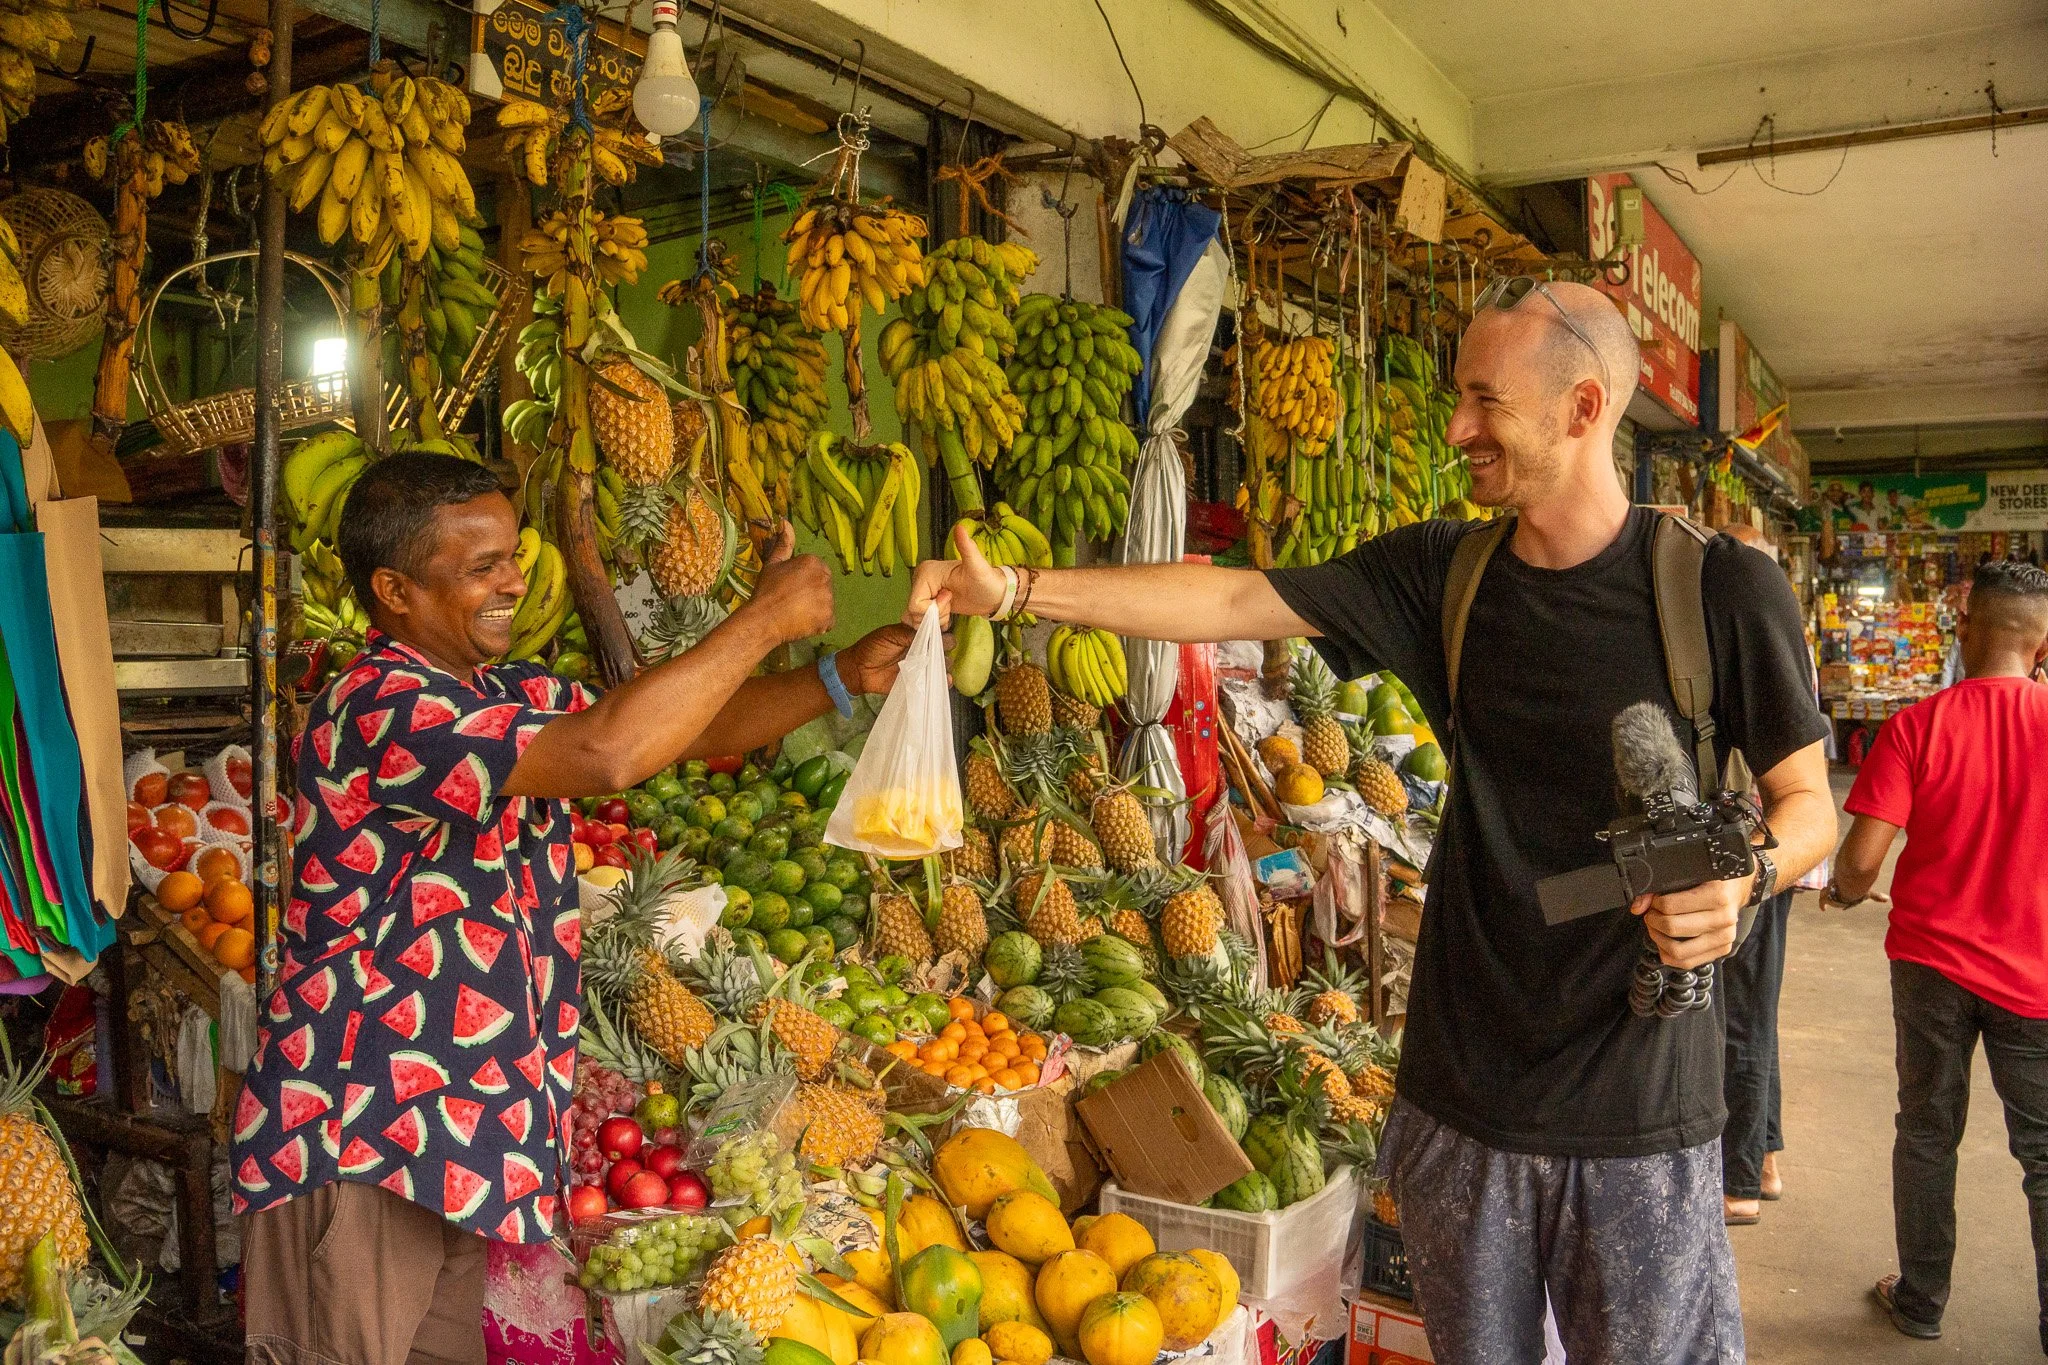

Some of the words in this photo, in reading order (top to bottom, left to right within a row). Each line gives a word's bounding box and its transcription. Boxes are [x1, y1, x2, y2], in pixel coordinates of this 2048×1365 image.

[1631, 243, 1699, 354] Telecom
[1991, 485, 2019, 496] NEW
[1998, 498, 2048, 509] STORES
